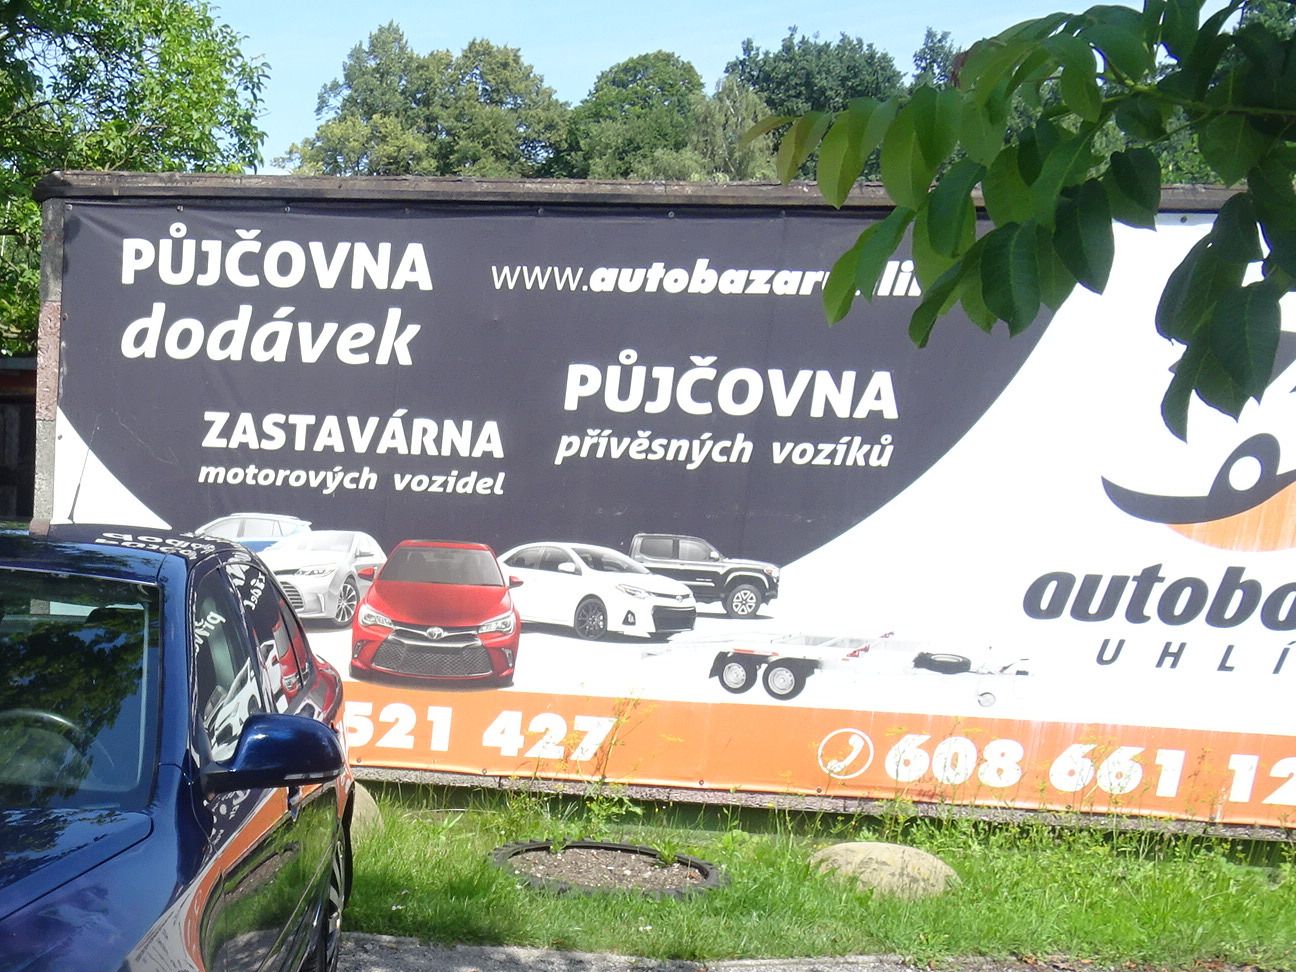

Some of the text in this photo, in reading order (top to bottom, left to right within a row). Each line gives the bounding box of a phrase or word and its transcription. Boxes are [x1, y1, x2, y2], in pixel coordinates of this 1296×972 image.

[121, 222, 433, 291] PŮJČOVNA
[491, 258, 923, 297] www.autobazarli
[120, 302, 422, 366] dodávek
[563, 348, 900, 420] PŮJČOVNA
[201, 408, 505, 459] ZASTAVÁRNA
[554, 428, 895, 470] přívěsných vozíků
[197, 465, 506, 496] motorových vozidel
[344, 701, 619, 762] 521 427
[884, 733, 1024, 788] 608
[1048, 743, 1186, 798] 661
